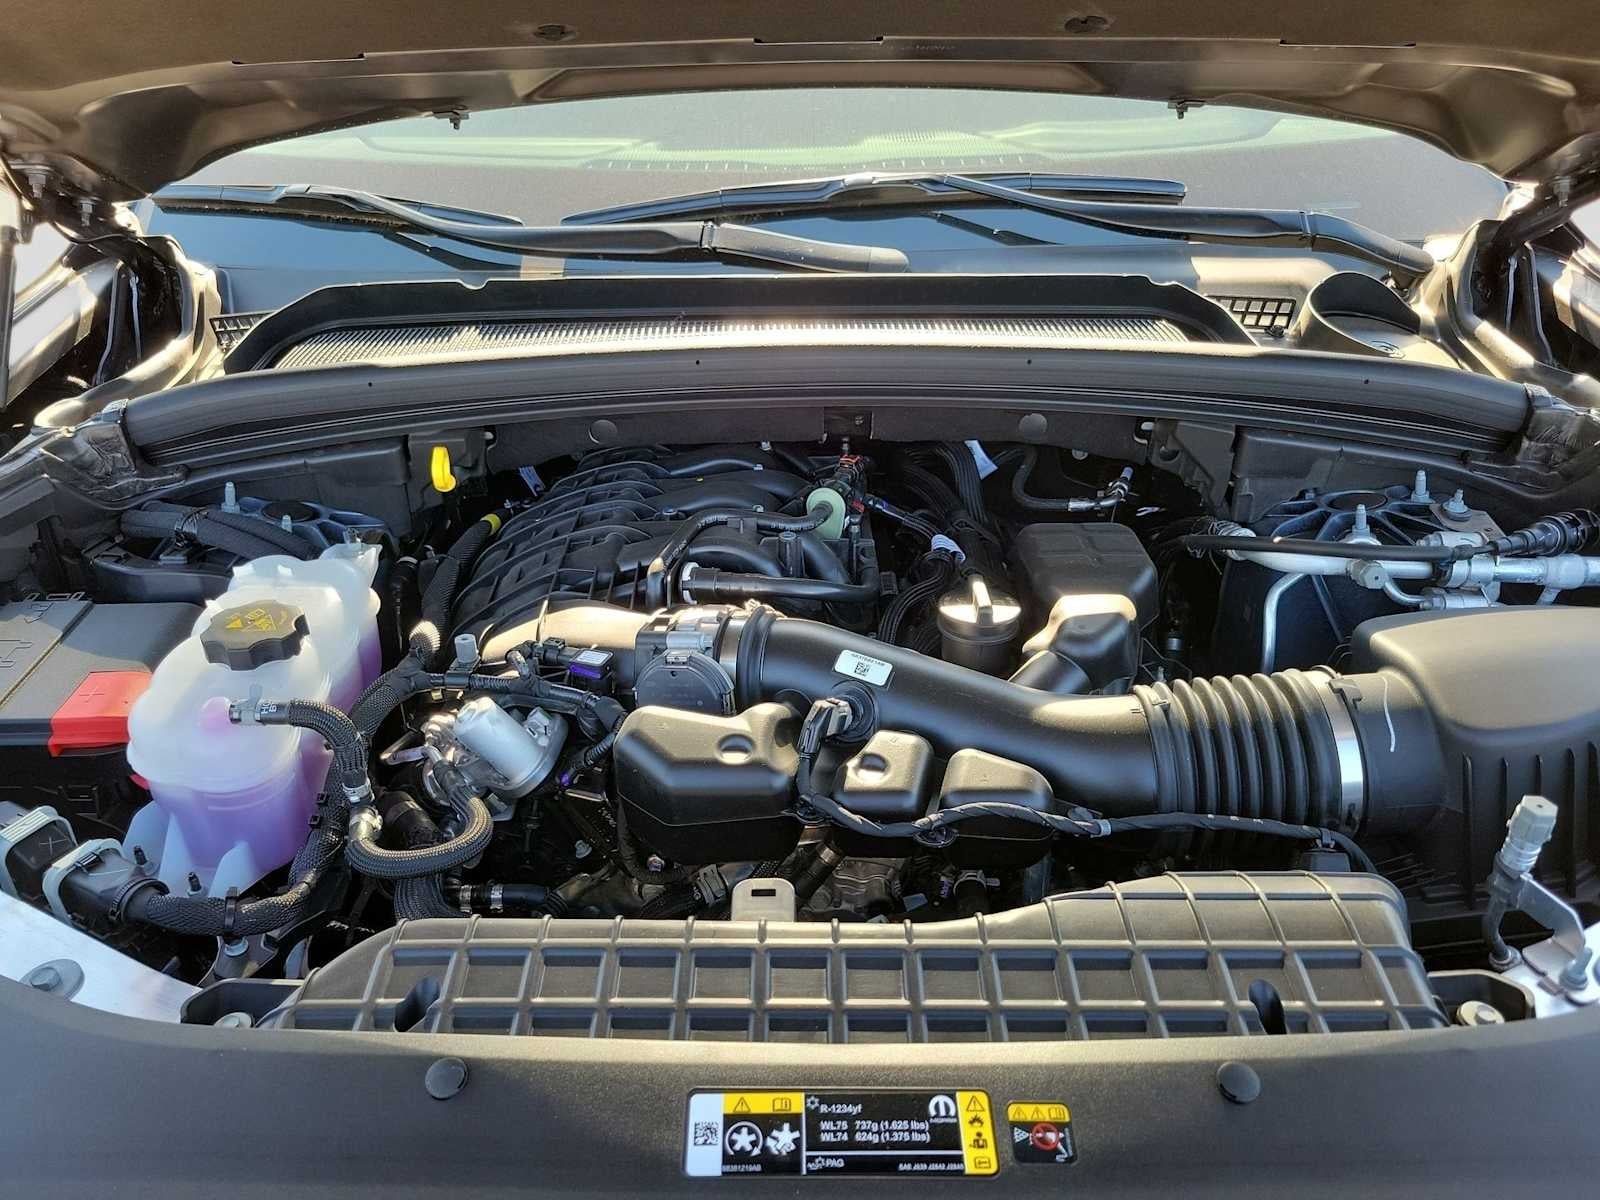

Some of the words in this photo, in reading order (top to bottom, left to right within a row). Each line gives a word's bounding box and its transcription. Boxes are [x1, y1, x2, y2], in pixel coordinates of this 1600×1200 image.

[820, 1103, 863, 1115] R-1234yf
[854, 1120, 878, 1132] 737g
[826, 1158, 845, 1168] PAG
